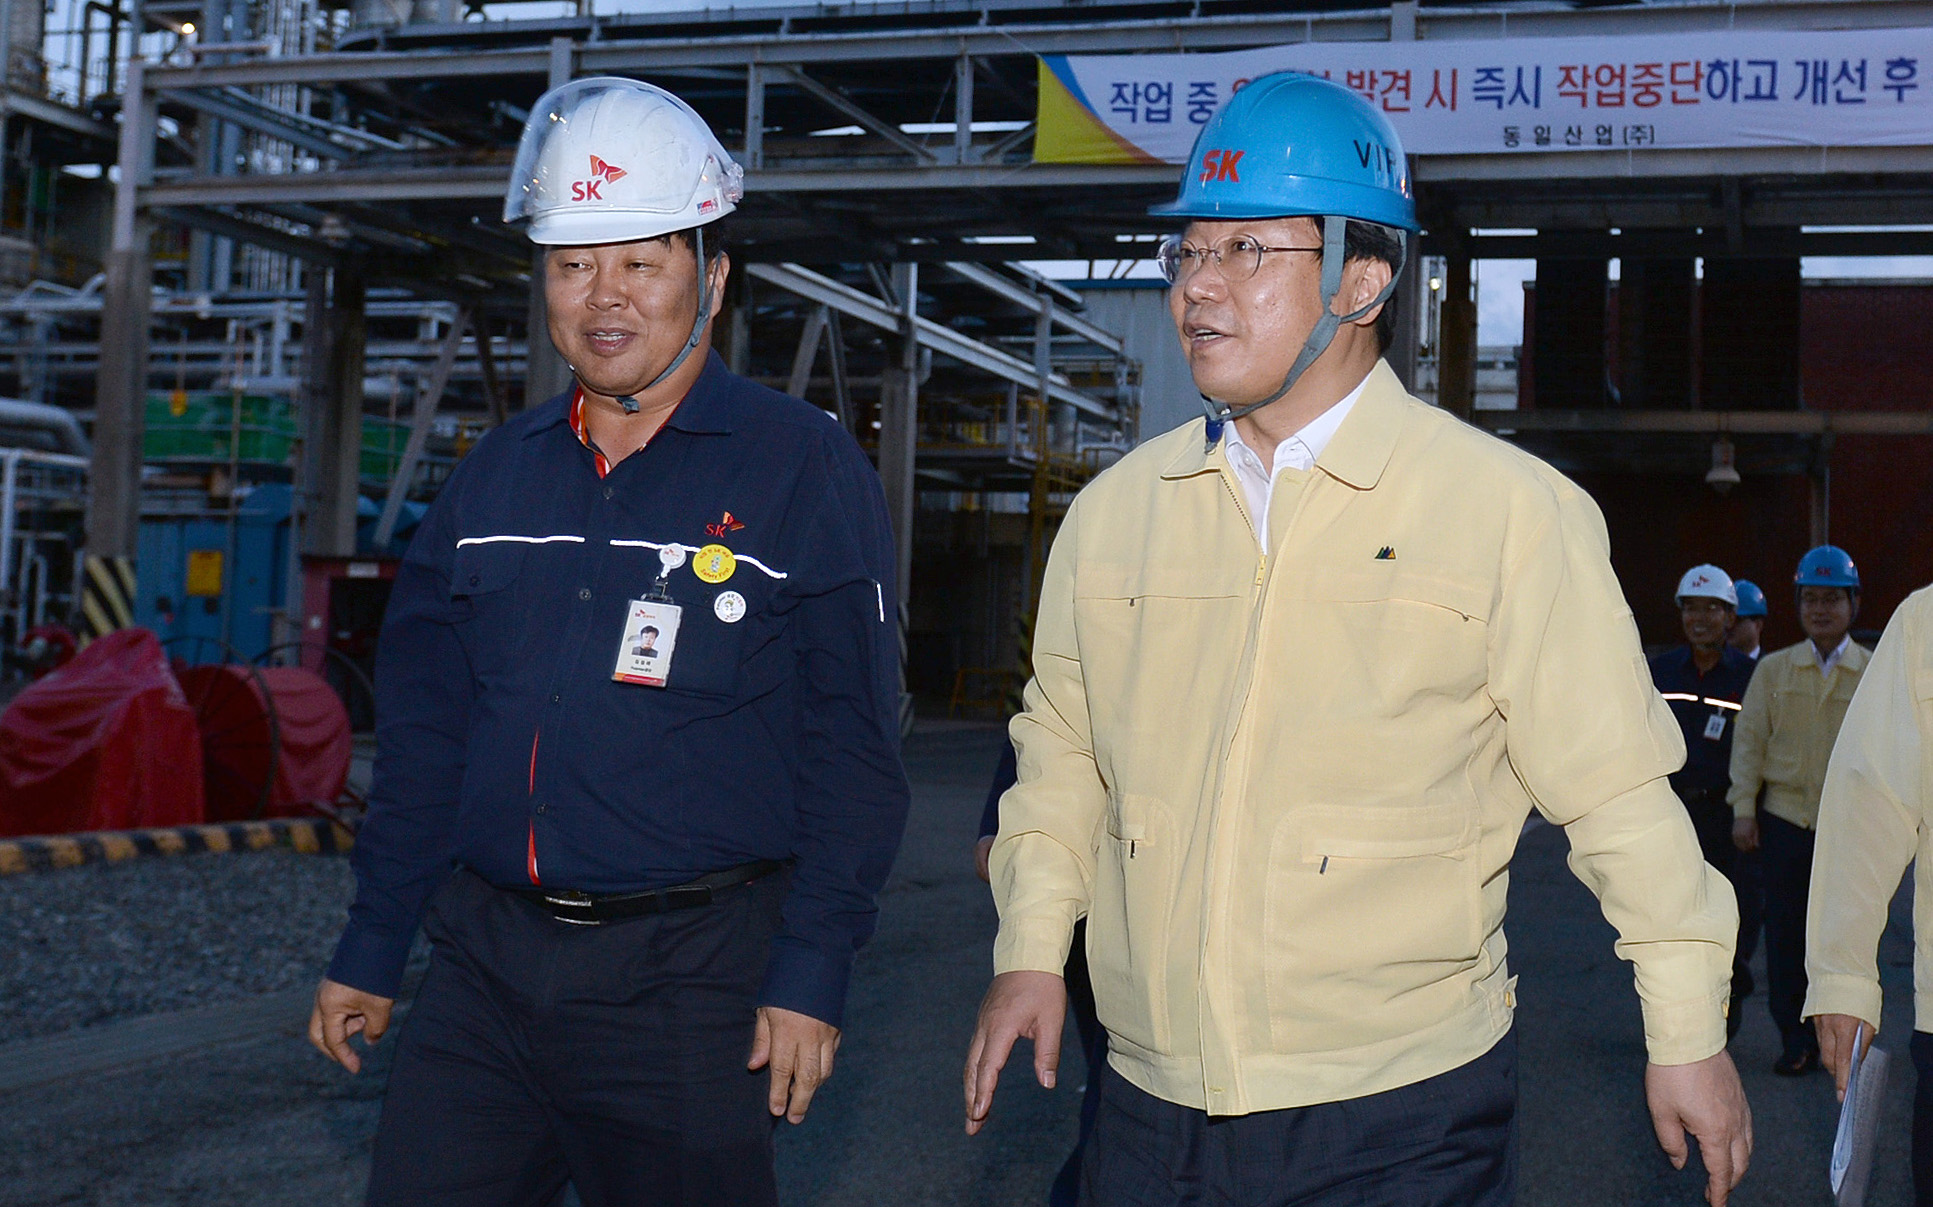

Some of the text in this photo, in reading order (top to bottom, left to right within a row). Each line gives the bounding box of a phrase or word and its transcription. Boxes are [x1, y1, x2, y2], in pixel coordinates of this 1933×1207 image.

[1110, 81, 1173, 124] 작업
[1187, 82, 1218, 124] 중
[1346, 69, 1412, 113] 발견
[1424, 68, 1459, 112] 시
[1472, 65, 1543, 109] 즉시
[1556, 58, 1780, 109] 작업중단하고
[1794, 58, 1868, 106] 개선
[1883, 57, 1919, 103] 후
[1200, 149, 1245, 183] SK
[1353, 139, 1397, 174] VIP
[571, 180, 603, 202] SK
[704, 523, 727, 538] SK
